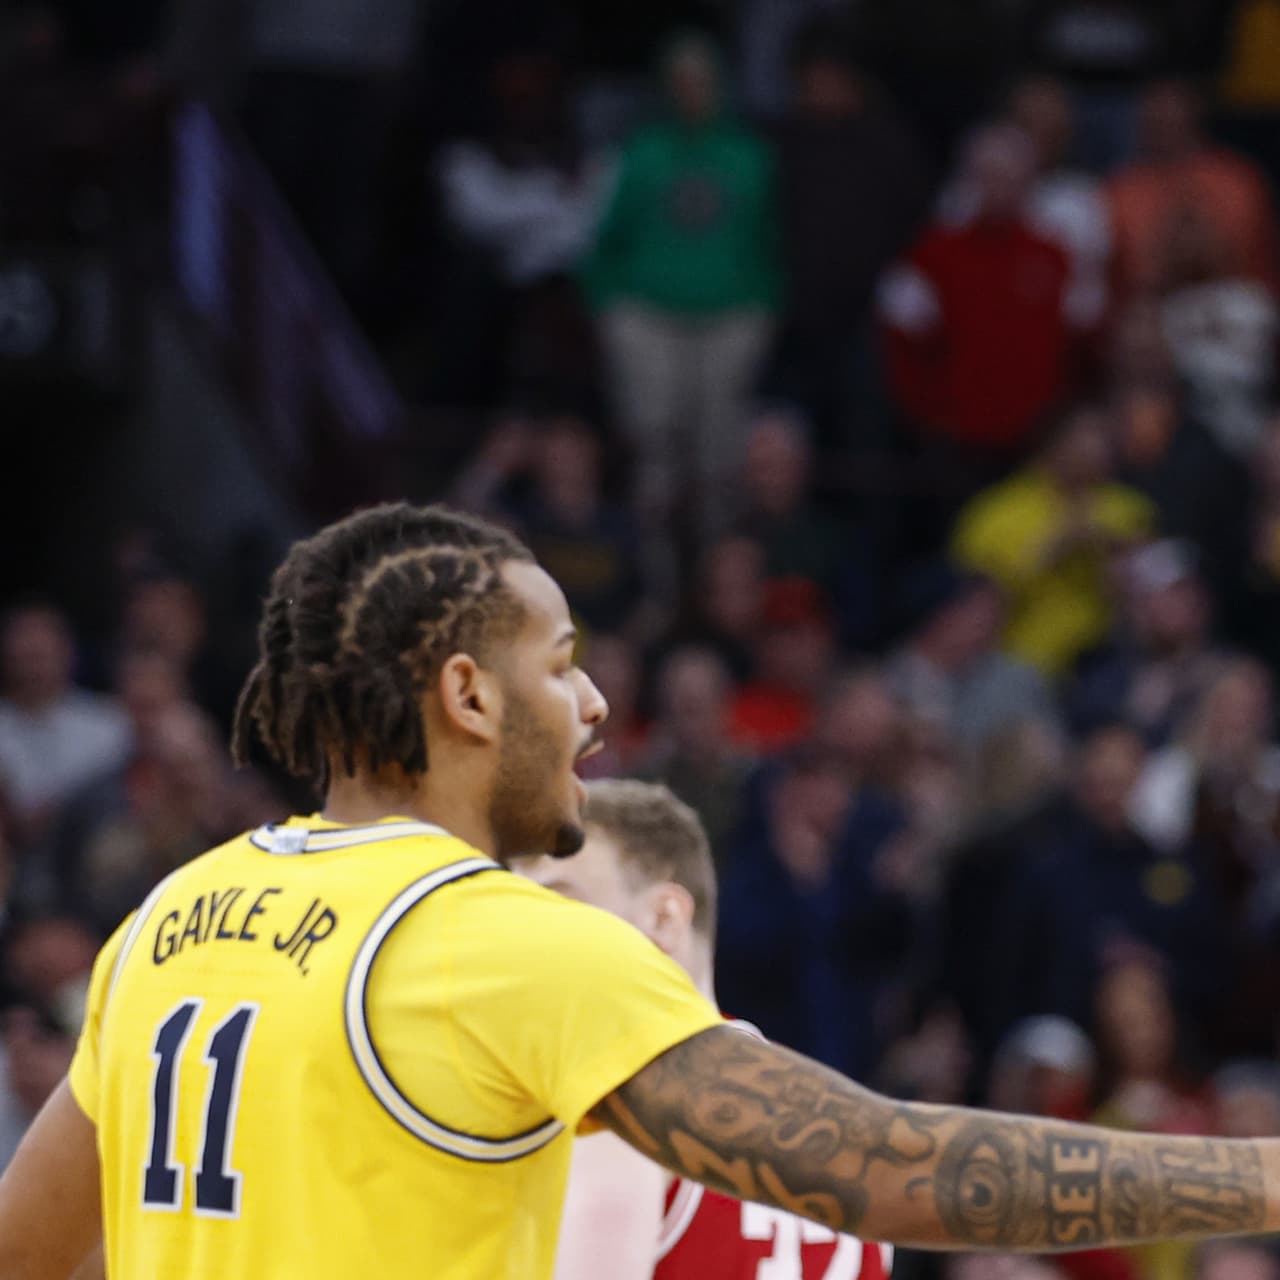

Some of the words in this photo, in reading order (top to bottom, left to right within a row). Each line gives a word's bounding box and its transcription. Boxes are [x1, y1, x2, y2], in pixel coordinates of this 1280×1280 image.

[153, 887, 283, 966] GAYLE
[272, 897, 338, 976] JR.
[141, 996, 261, 1219] 11
